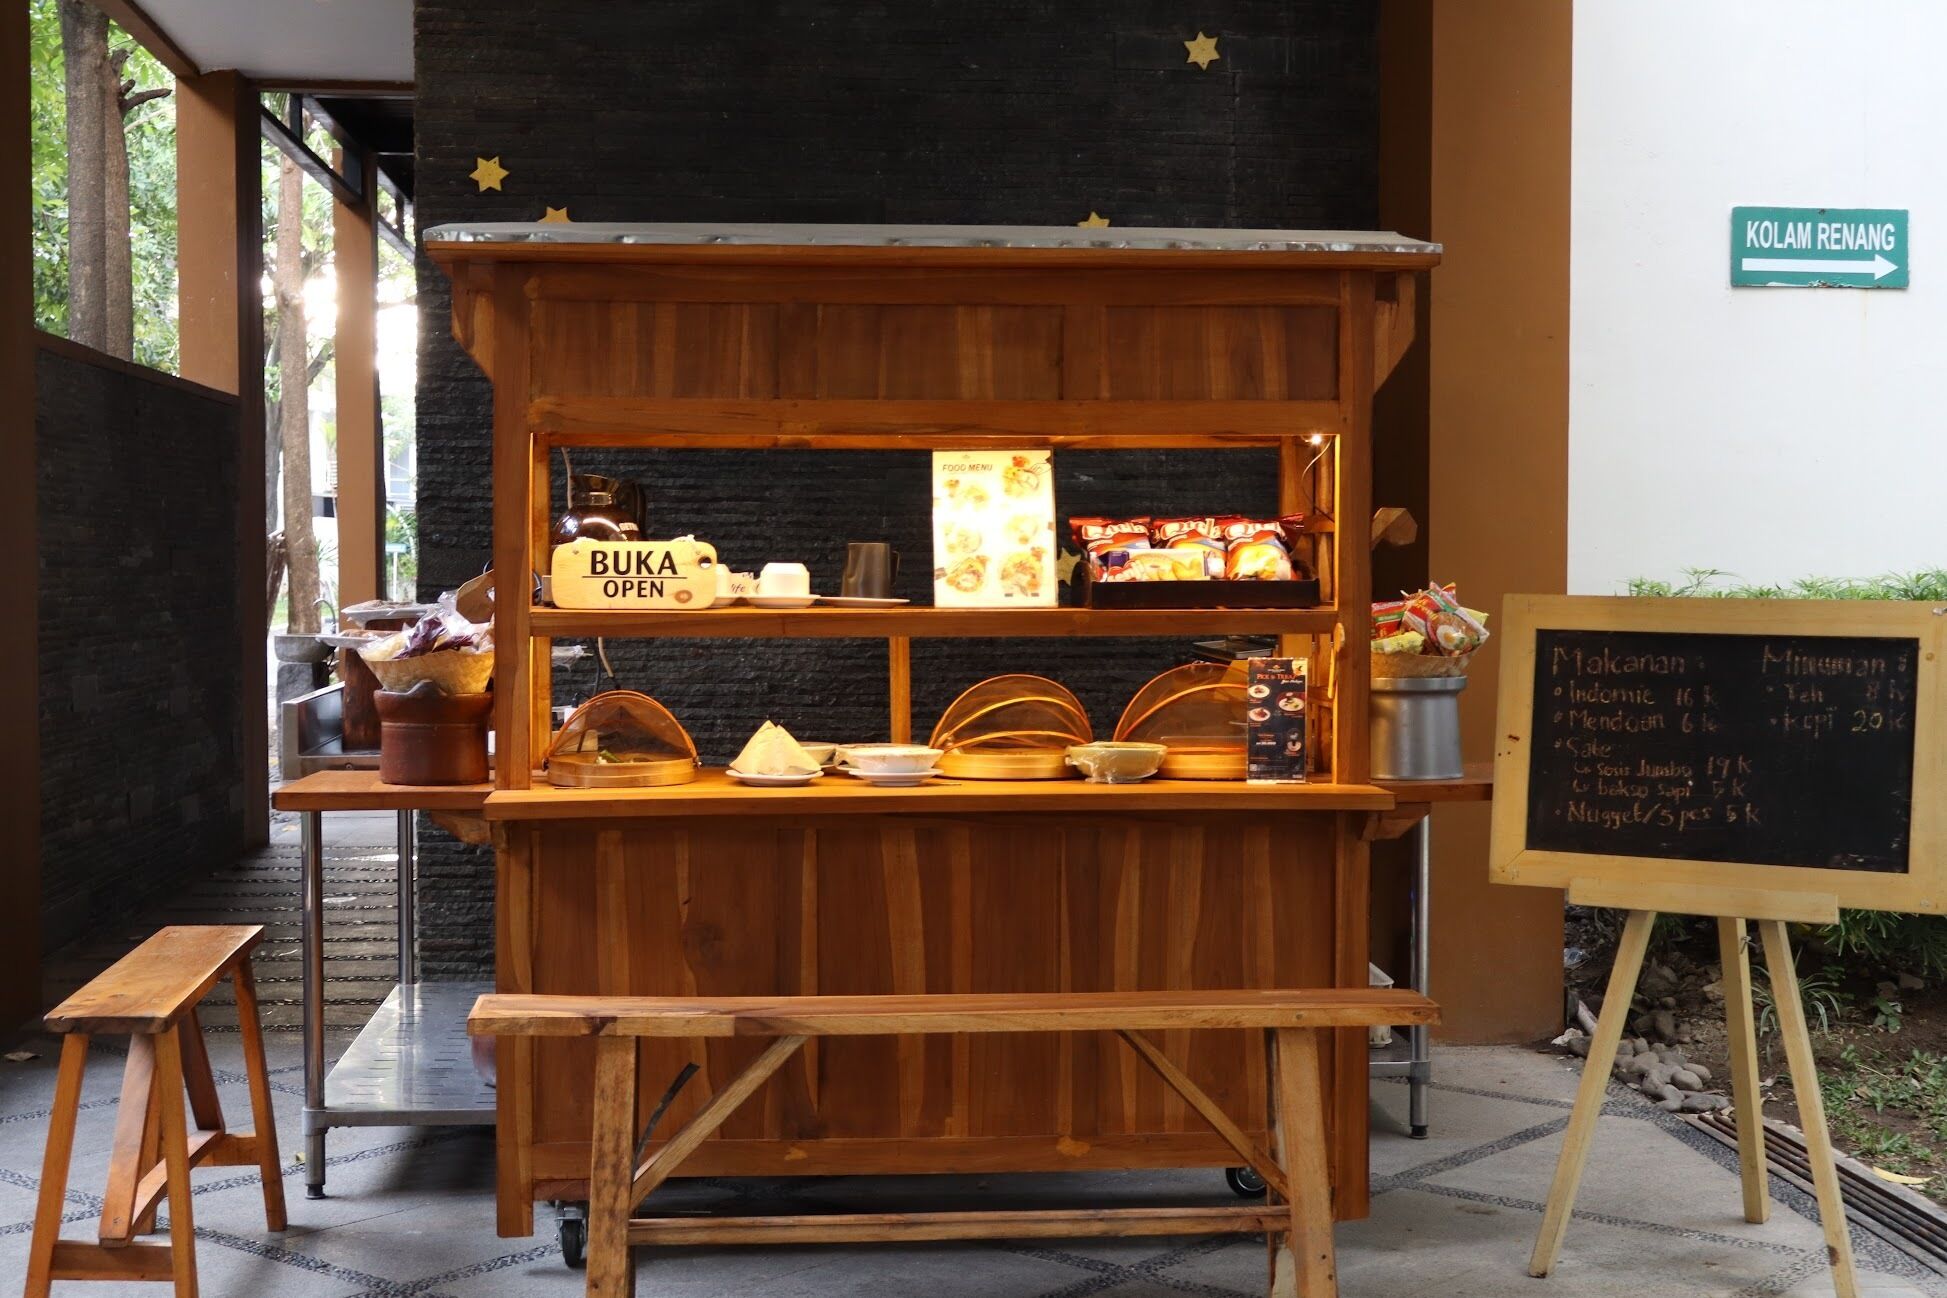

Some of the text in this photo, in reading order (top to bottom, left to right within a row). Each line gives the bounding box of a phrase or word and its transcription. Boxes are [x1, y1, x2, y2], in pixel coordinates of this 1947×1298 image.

[1746, 220, 1896, 251] KOLAM RENANG
[942, 463, 993, 472] FOOD MENU
[590, 550, 678, 576] BUKA
[603, 579, 664, 598] OPEN
[1552, 646, 1685, 676] Makanan
[1570, 680, 1656, 705] Indomie
[1675, 687, 1694, 707] 16
[1569, 710, 1666, 733] Mendoan
[1681, 712, 1693, 733] 6
[1851, 709, 1884, 732] 20
[1566, 737, 1612, 758] Sate
[1707, 755, 1731, 779] 19
